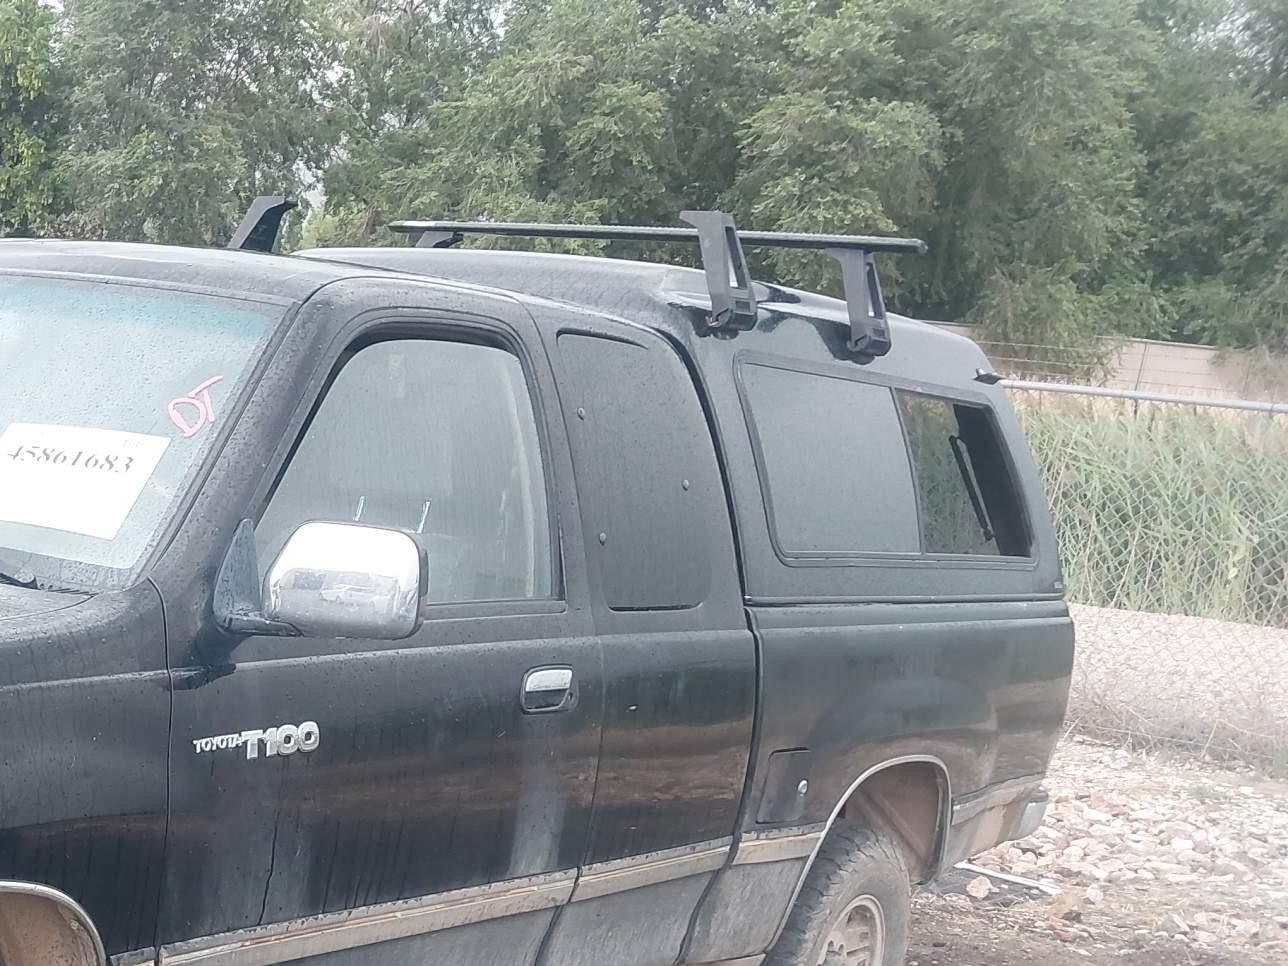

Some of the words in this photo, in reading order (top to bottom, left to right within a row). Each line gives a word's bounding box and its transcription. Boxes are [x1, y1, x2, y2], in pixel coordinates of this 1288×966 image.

[7, 445, 135, 473] 45861683
[192, 733, 243, 754] TOYOTA
[241, 720, 320, 760] T100
